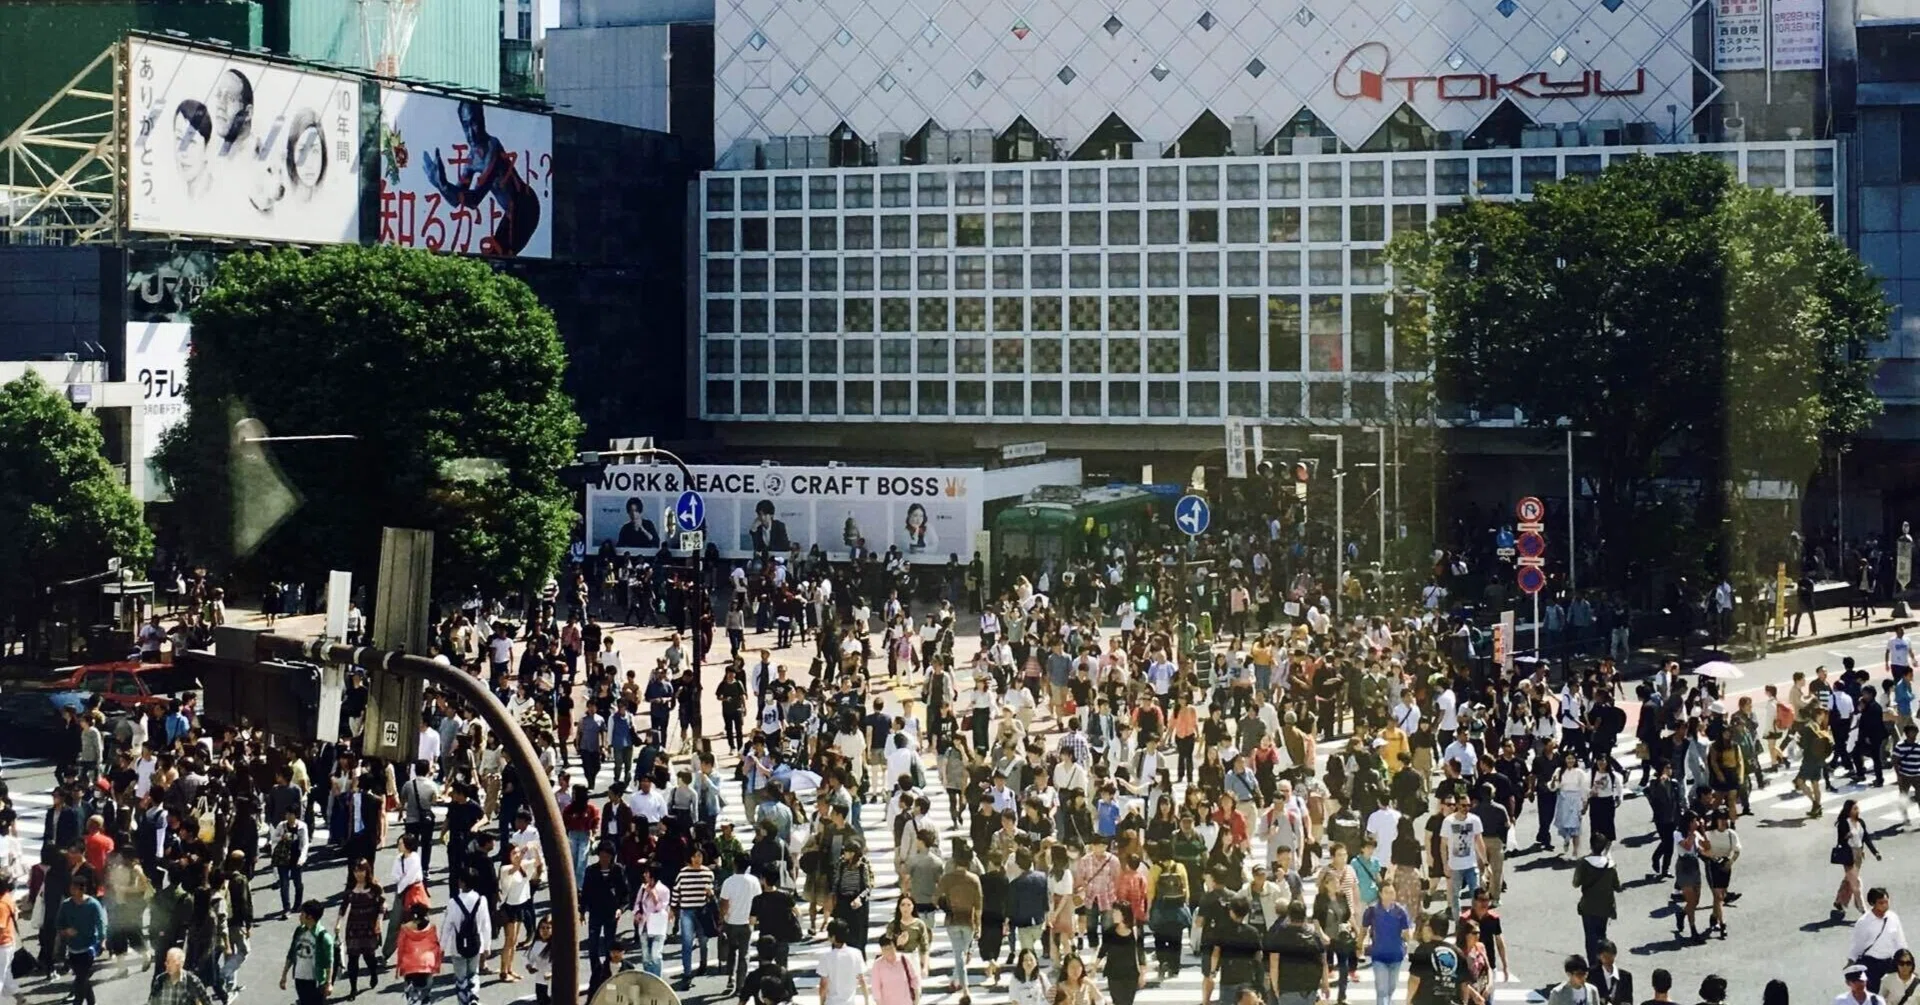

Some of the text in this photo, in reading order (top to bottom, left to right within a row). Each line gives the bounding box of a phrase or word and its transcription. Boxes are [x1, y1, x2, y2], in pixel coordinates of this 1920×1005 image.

[1386, 67, 1645, 102] TOKYU
[139, 56, 157, 204] ありがとう。
[791, 475, 870, 495] CRAFT
[877, 477, 939, 497] BOSS
